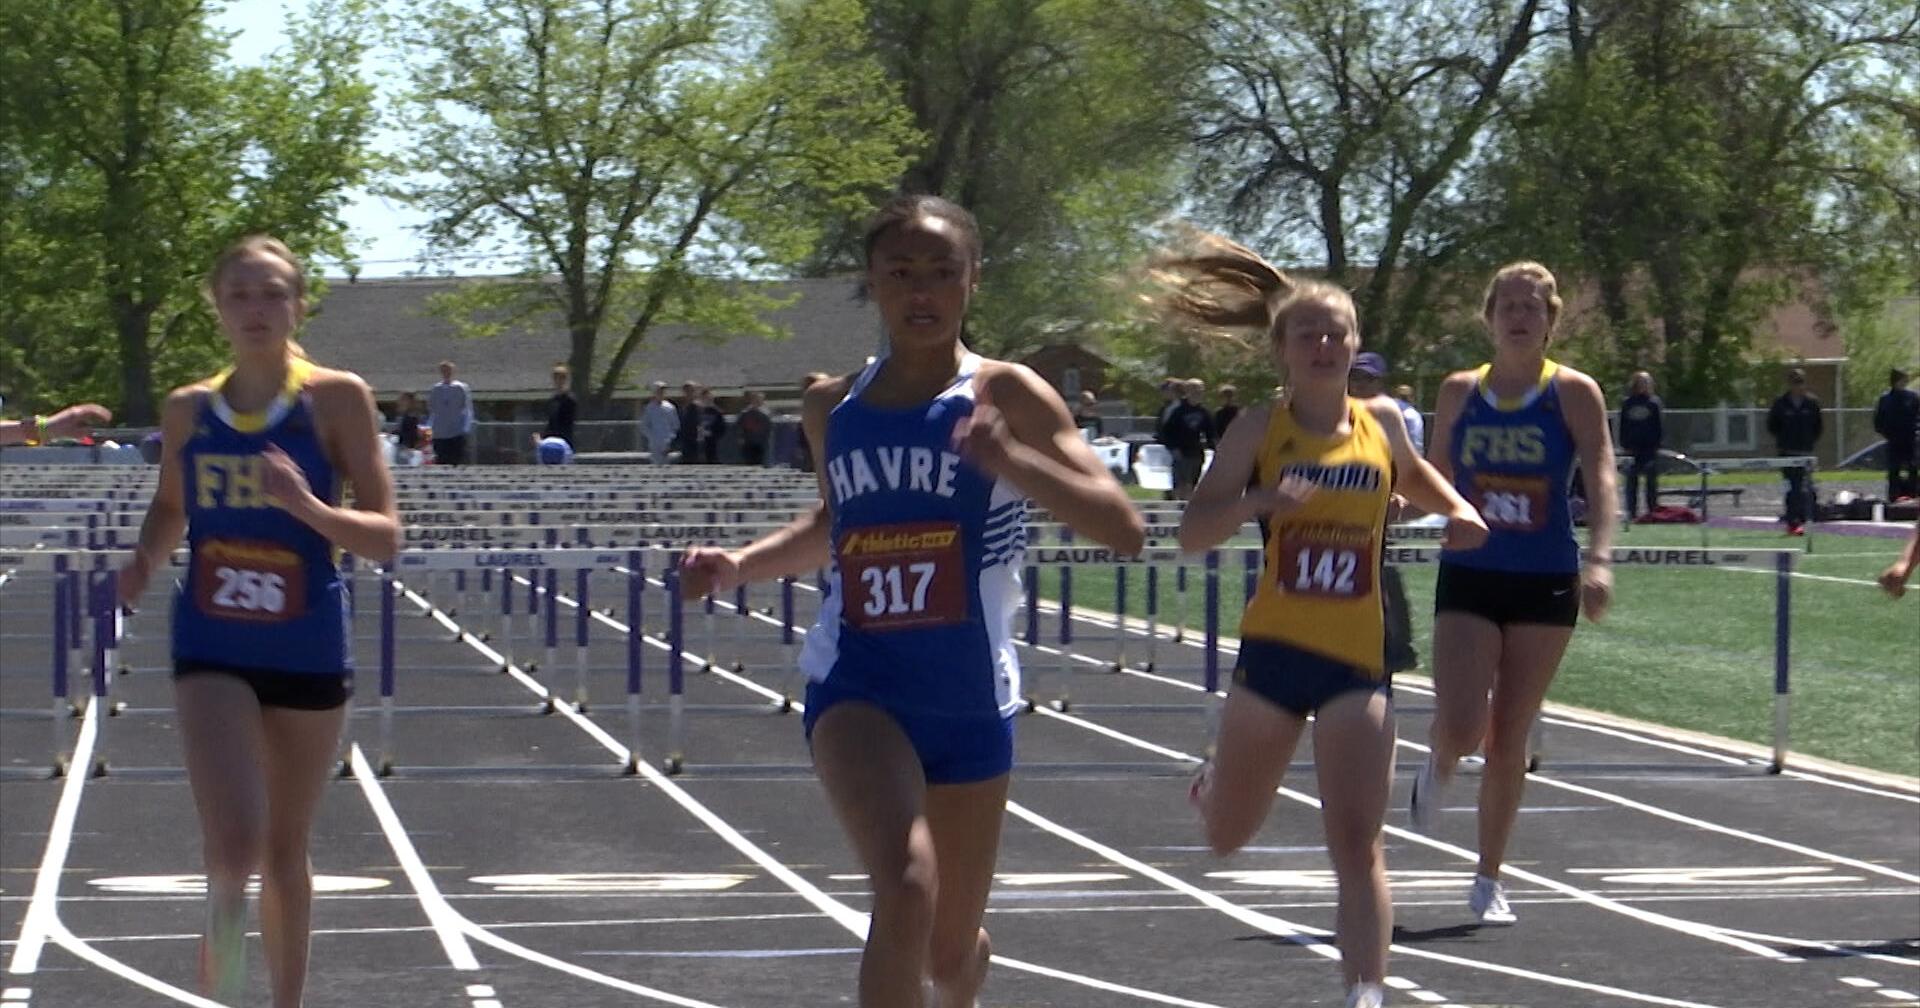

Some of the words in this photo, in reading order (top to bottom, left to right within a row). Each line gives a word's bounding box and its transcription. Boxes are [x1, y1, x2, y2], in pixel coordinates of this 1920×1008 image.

[1461, 425, 1546, 466] FHS
[828, 446, 961, 503] HAVRE
[585, 512, 660, 524] LAUREL
[1482, 491, 1532, 524] 261
[404, 527, 495, 541] LAUREL
[640, 526, 731, 540] LAUREL
[475, 553, 546, 567] LAUREL
[1296, 548, 1358, 593] 142
[1611, 550, 1716, 565] LAUREL
[212, 566, 287, 613] 256
[861, 562, 936, 617] 317
